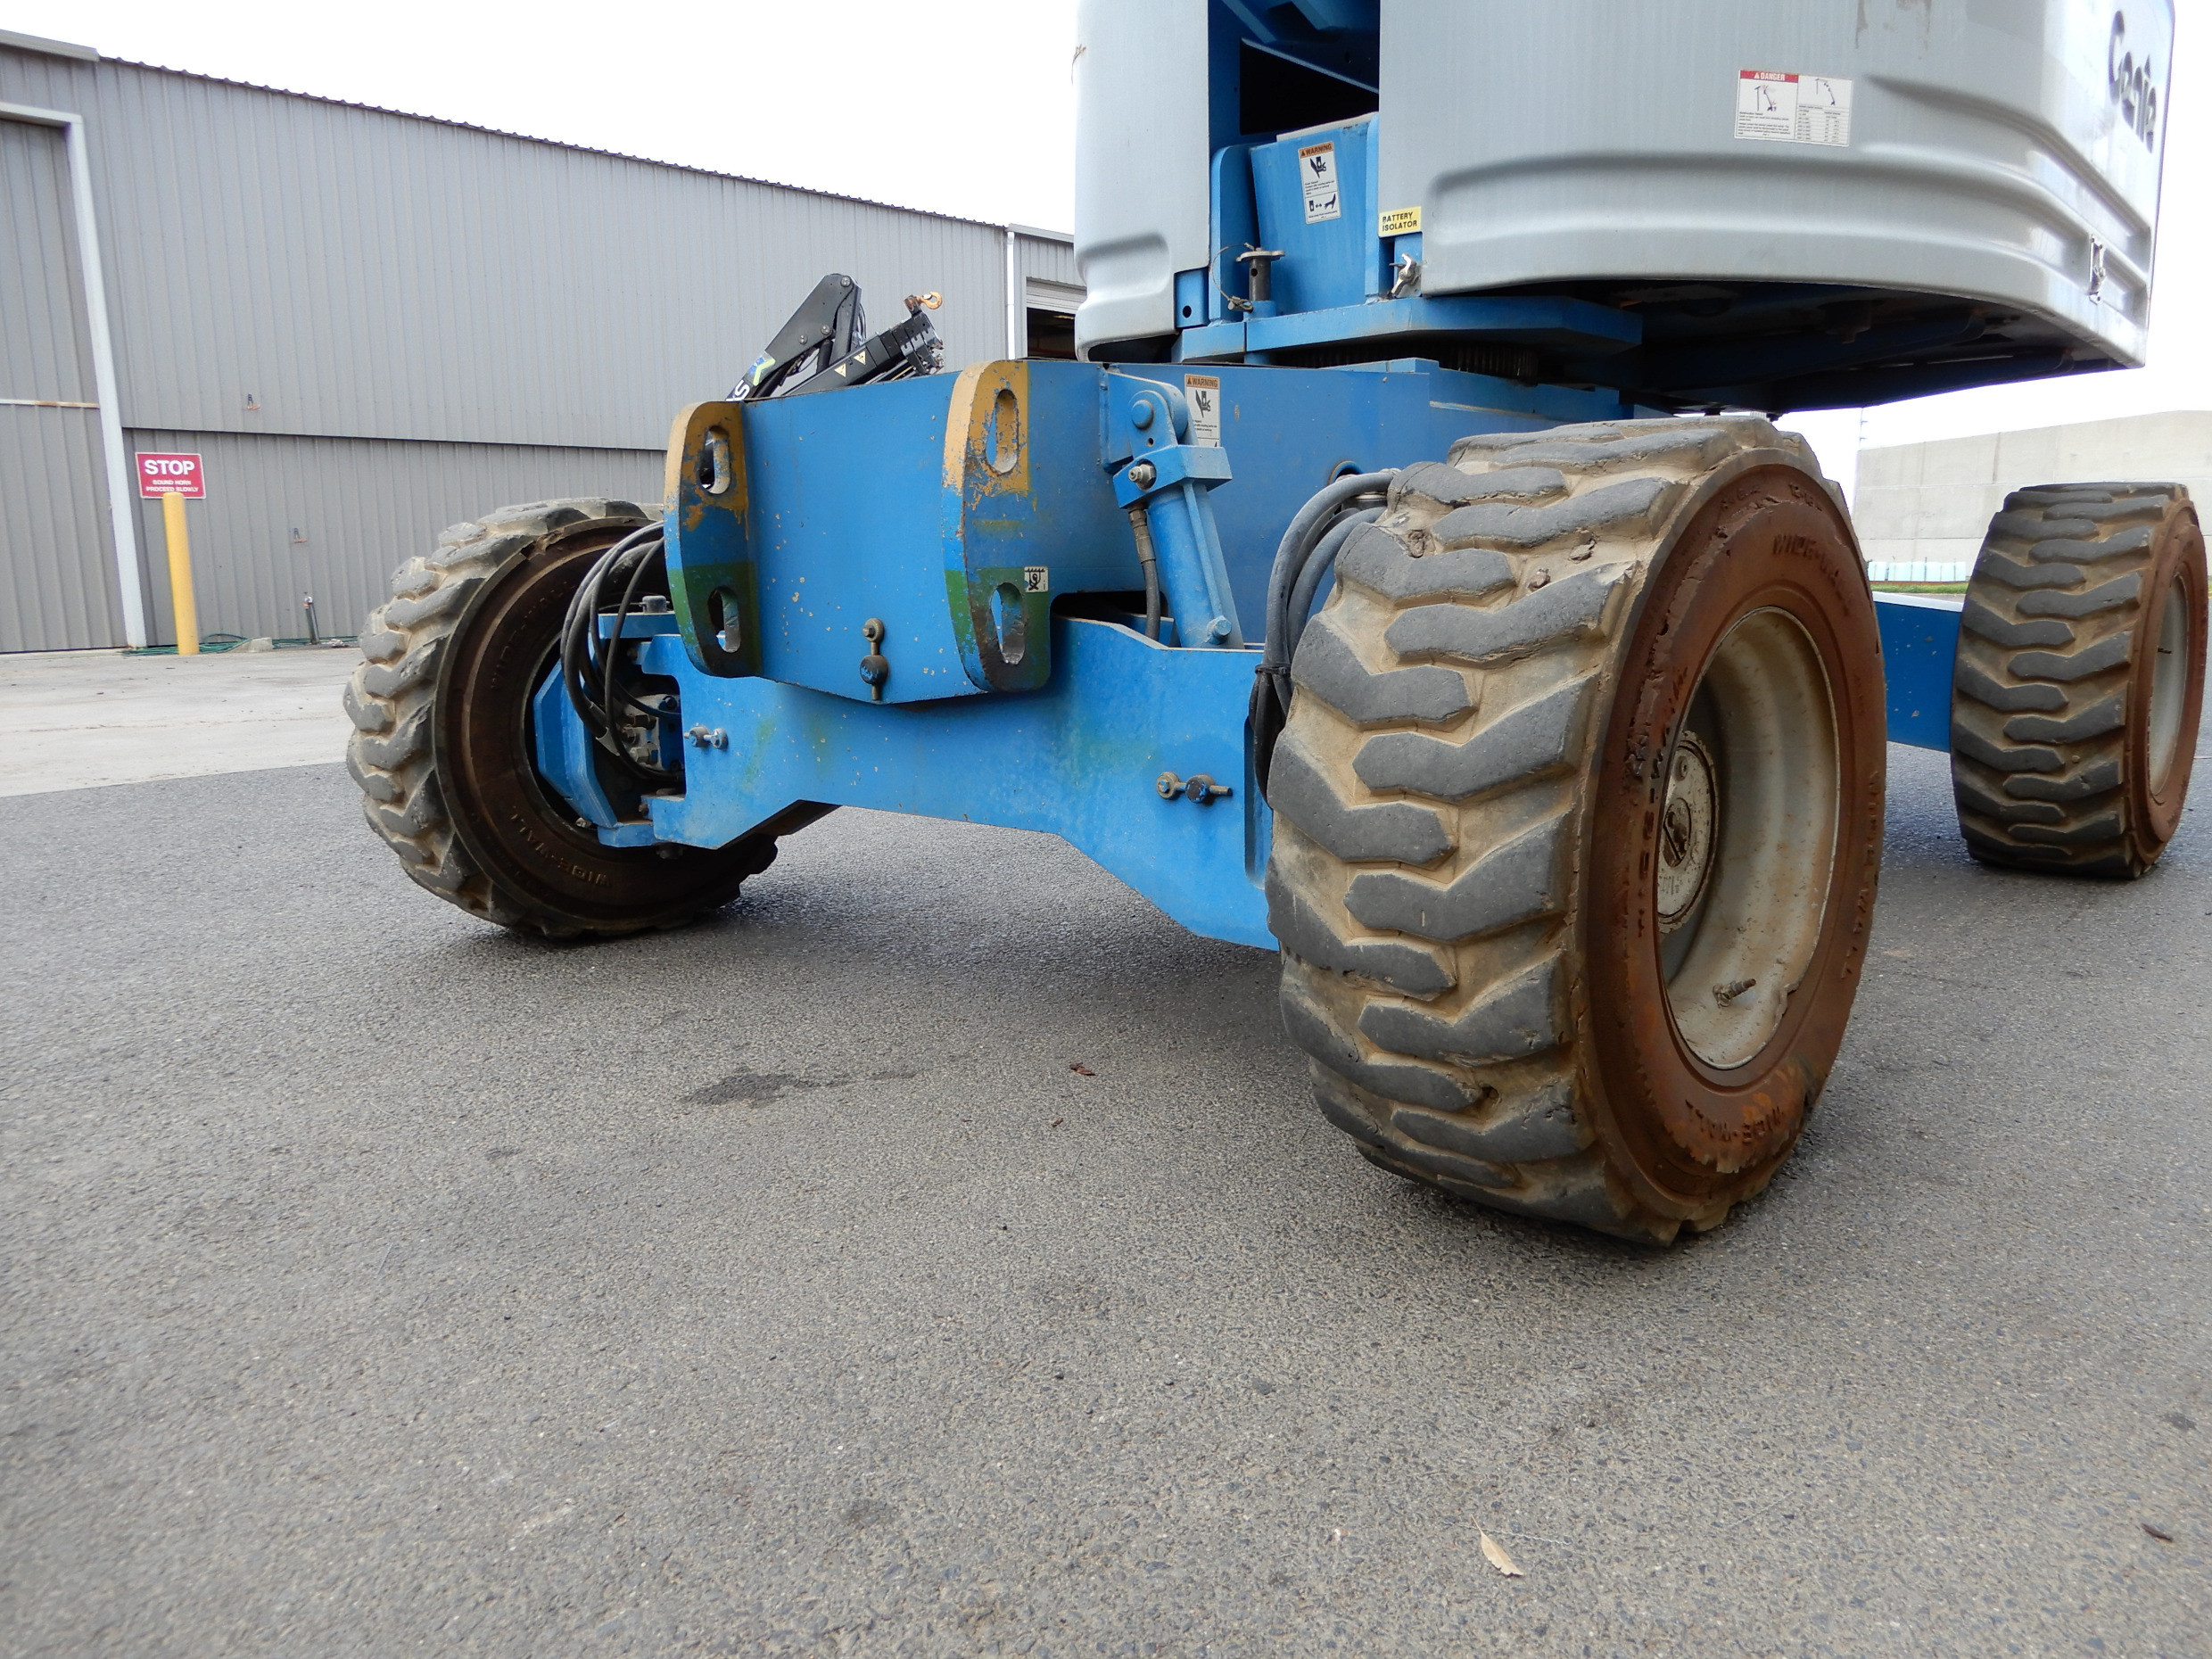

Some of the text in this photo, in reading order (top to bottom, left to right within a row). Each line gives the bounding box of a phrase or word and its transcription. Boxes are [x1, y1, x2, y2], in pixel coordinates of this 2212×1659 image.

[1760, 72, 1786, 81] DANGER
[2109, 11, 2157, 153] Genie
[1305, 143, 1333, 156] WARNING
[1382, 212, 1414, 223] BATTERY
[1382, 220, 1417, 231] ISOLATOR
[1193, 377, 1217, 387] WARNING
[144, 459, 194, 475] STOP
